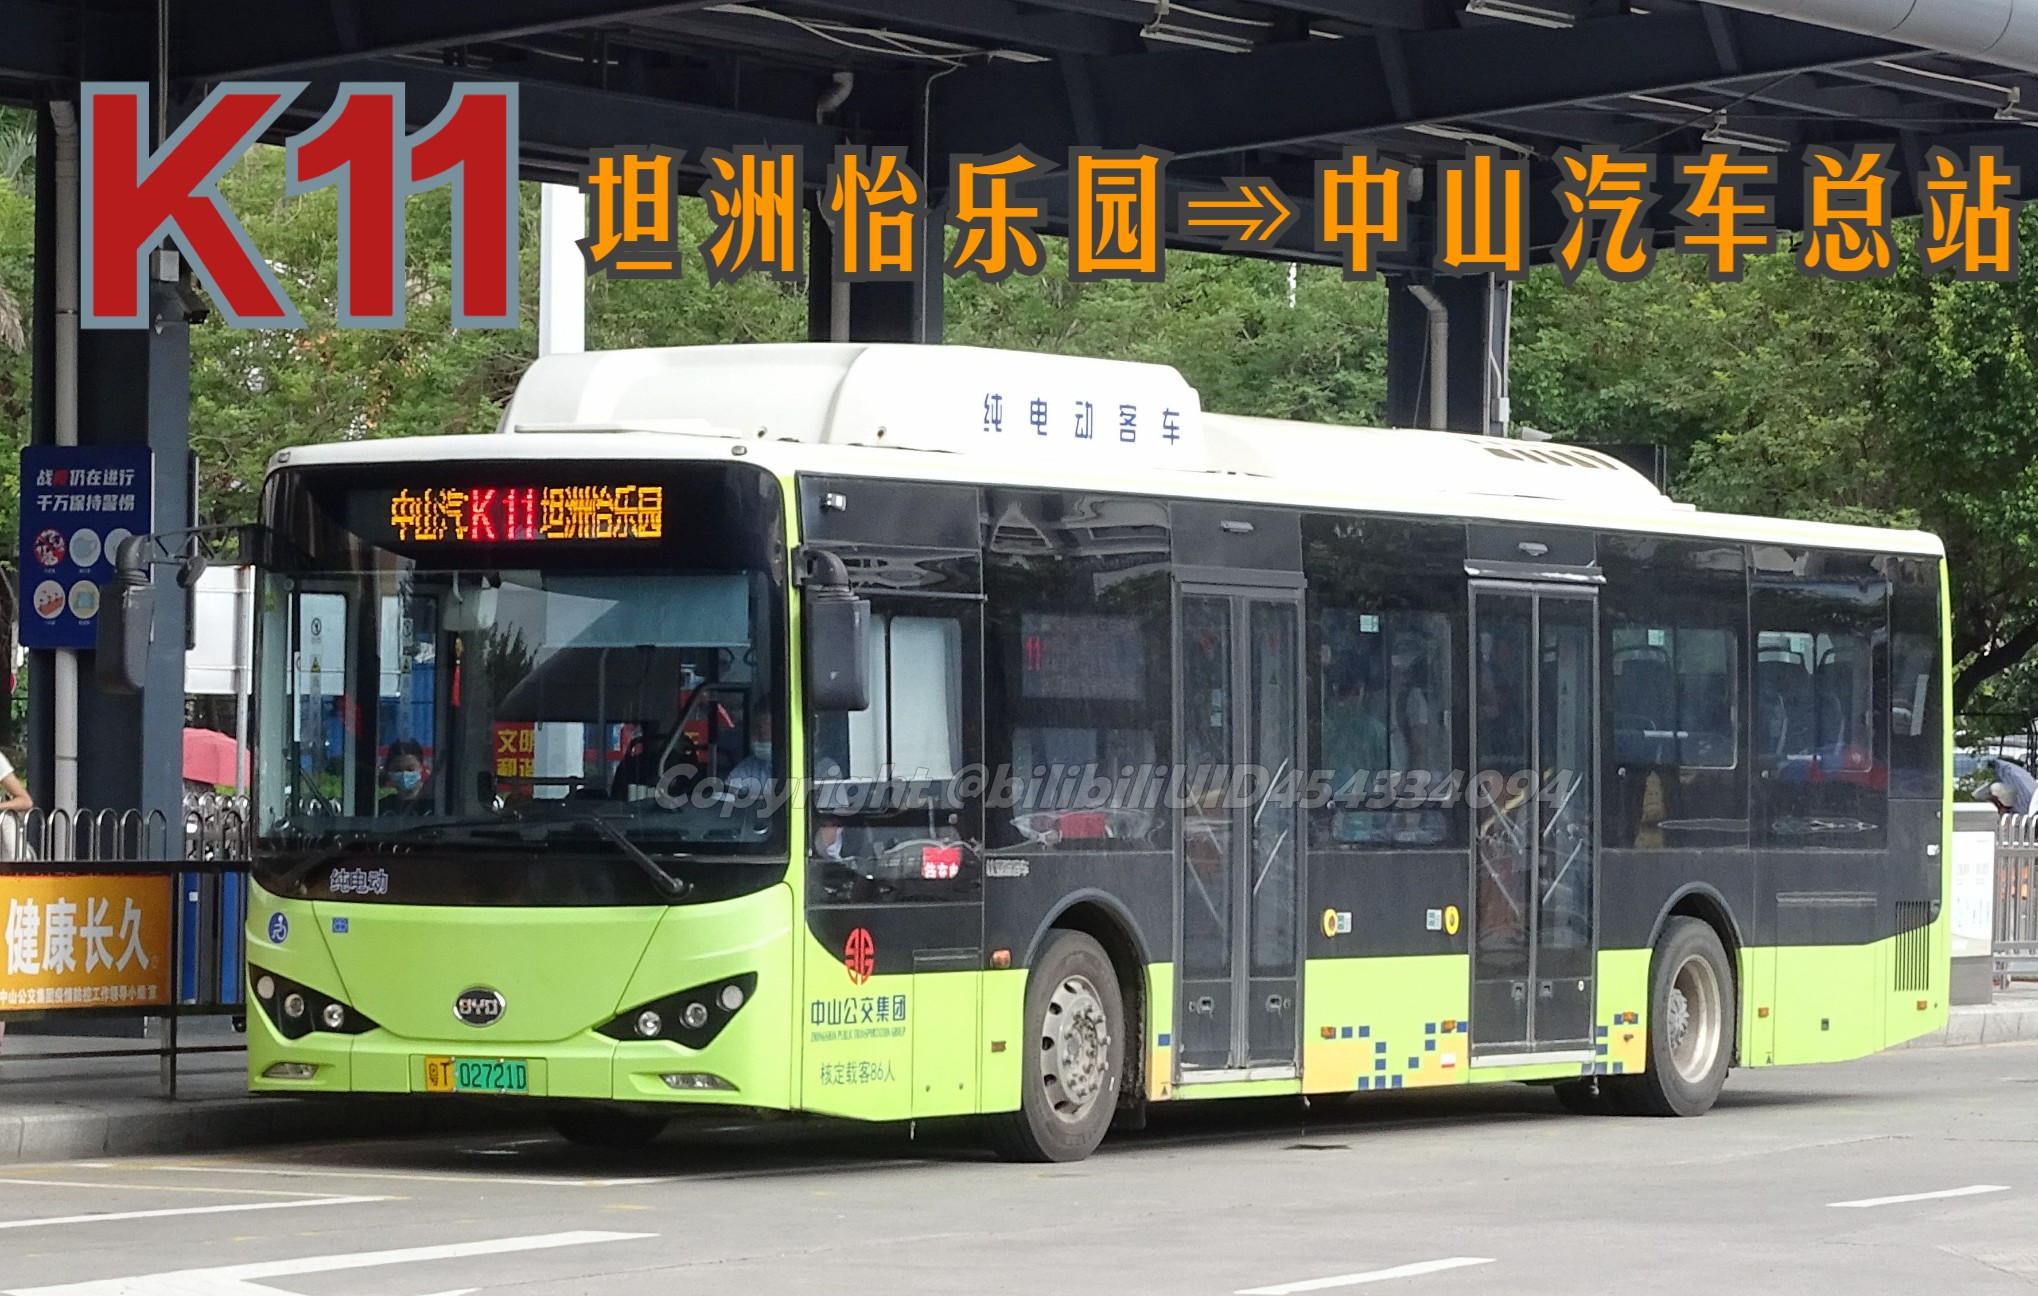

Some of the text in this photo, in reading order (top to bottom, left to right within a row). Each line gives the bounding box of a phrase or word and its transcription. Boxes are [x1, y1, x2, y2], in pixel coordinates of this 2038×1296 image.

[983, 393, 1180, 446] 纯电动客车
[470, 487, 535, 541] K11
[540, 485, 663, 540] 坦洲怡乐园
[329, 867, 389, 895] 纯电动
[5, 897, 150, 976] 健康长久
[458, 998, 498, 1015] BYD
[811, 994, 907, 1026] 中山公交集团
[820, 1059, 896, 1086] 核定载客86人
